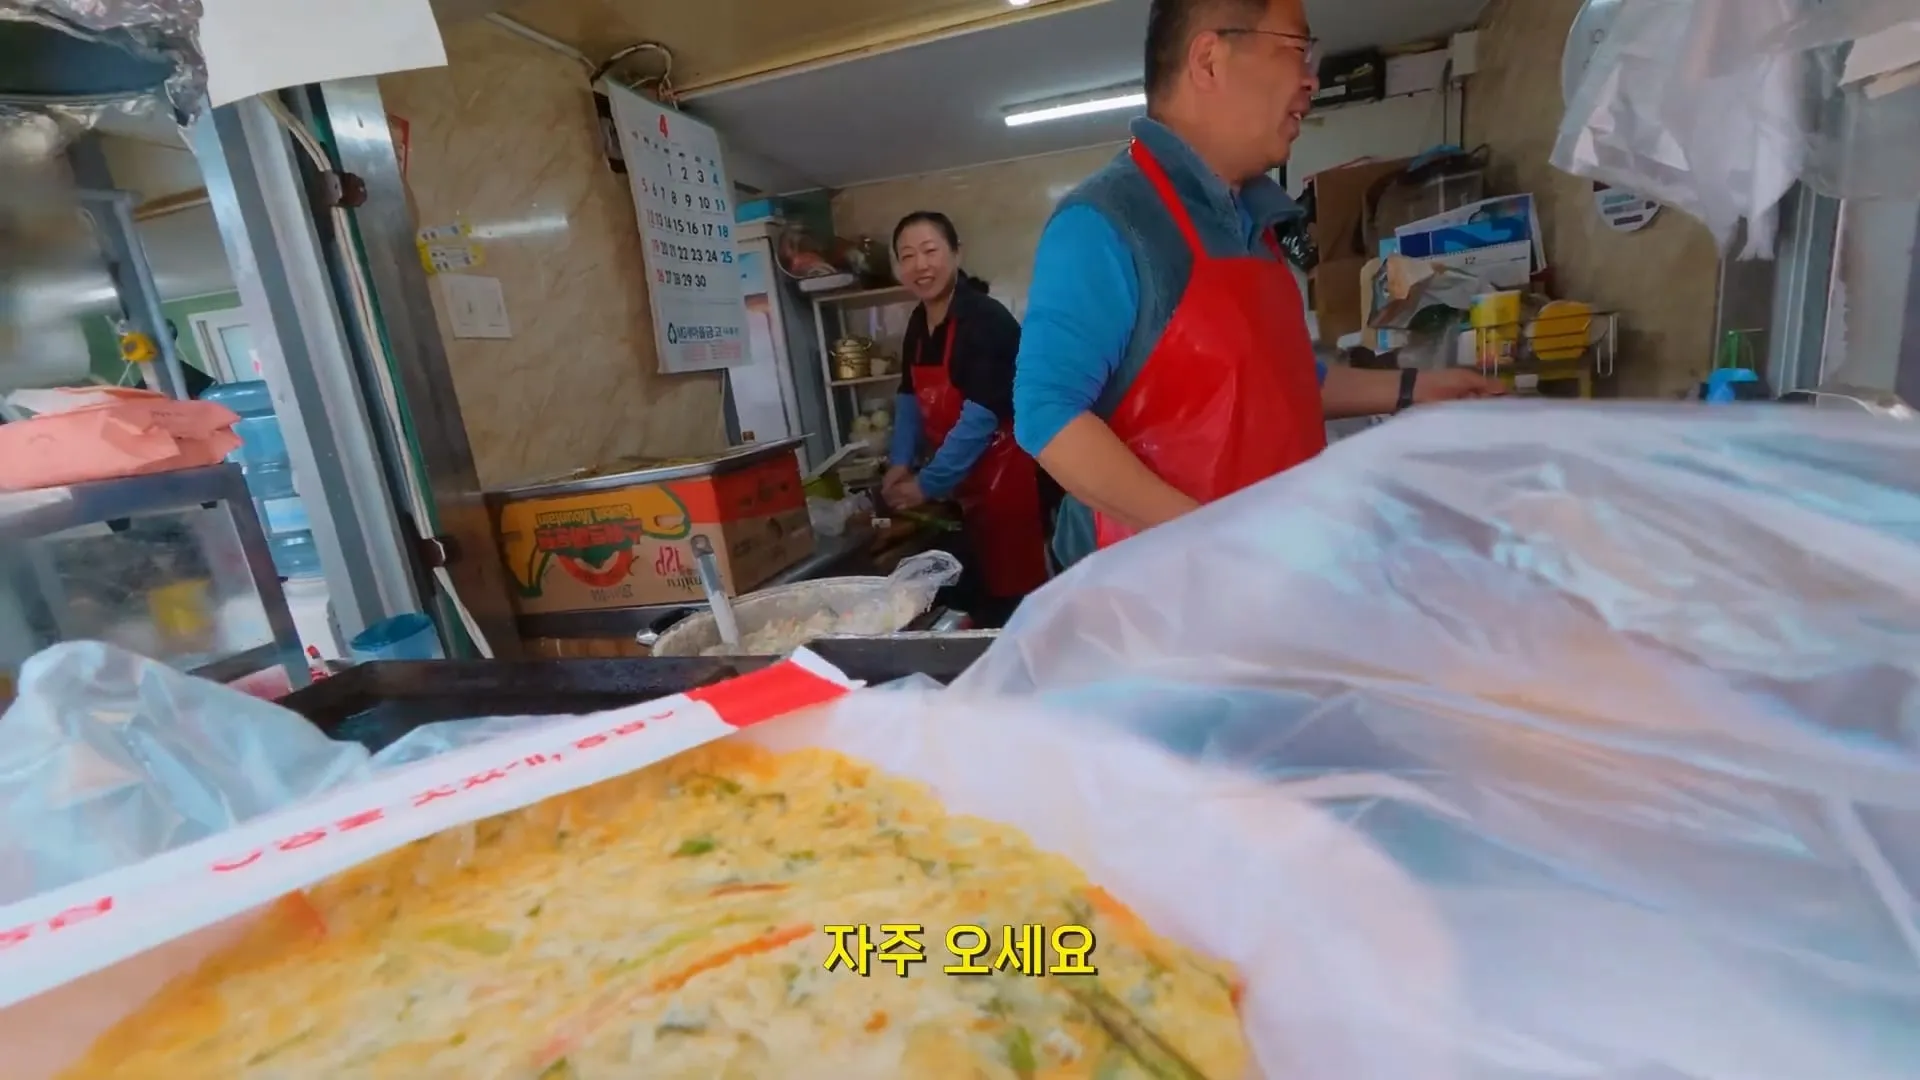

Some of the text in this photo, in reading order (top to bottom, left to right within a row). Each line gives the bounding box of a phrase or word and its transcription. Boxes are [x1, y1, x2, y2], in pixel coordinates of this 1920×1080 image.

[659, 113, 669, 138] 4
[666, 163, 719, 186] 1 2 3 4
[641, 178, 726, 211] 5 6 7 8 9 10 11
[673, 219, 684, 232] 15
[686, 222, 699, 235] 16
[702, 223, 713, 236] 17
[717, 225, 729, 238] 18
[678, 246, 689, 260] 22
[691, 248, 703, 261] 23
[706, 249, 718, 262] 24
[721, 251, 733, 263] 25
[1464, 257, 1476, 265] 12
[682, 273, 692, 287] 29
[695, 275, 706, 288] 30
[536, 510, 593, 527] Mountain
